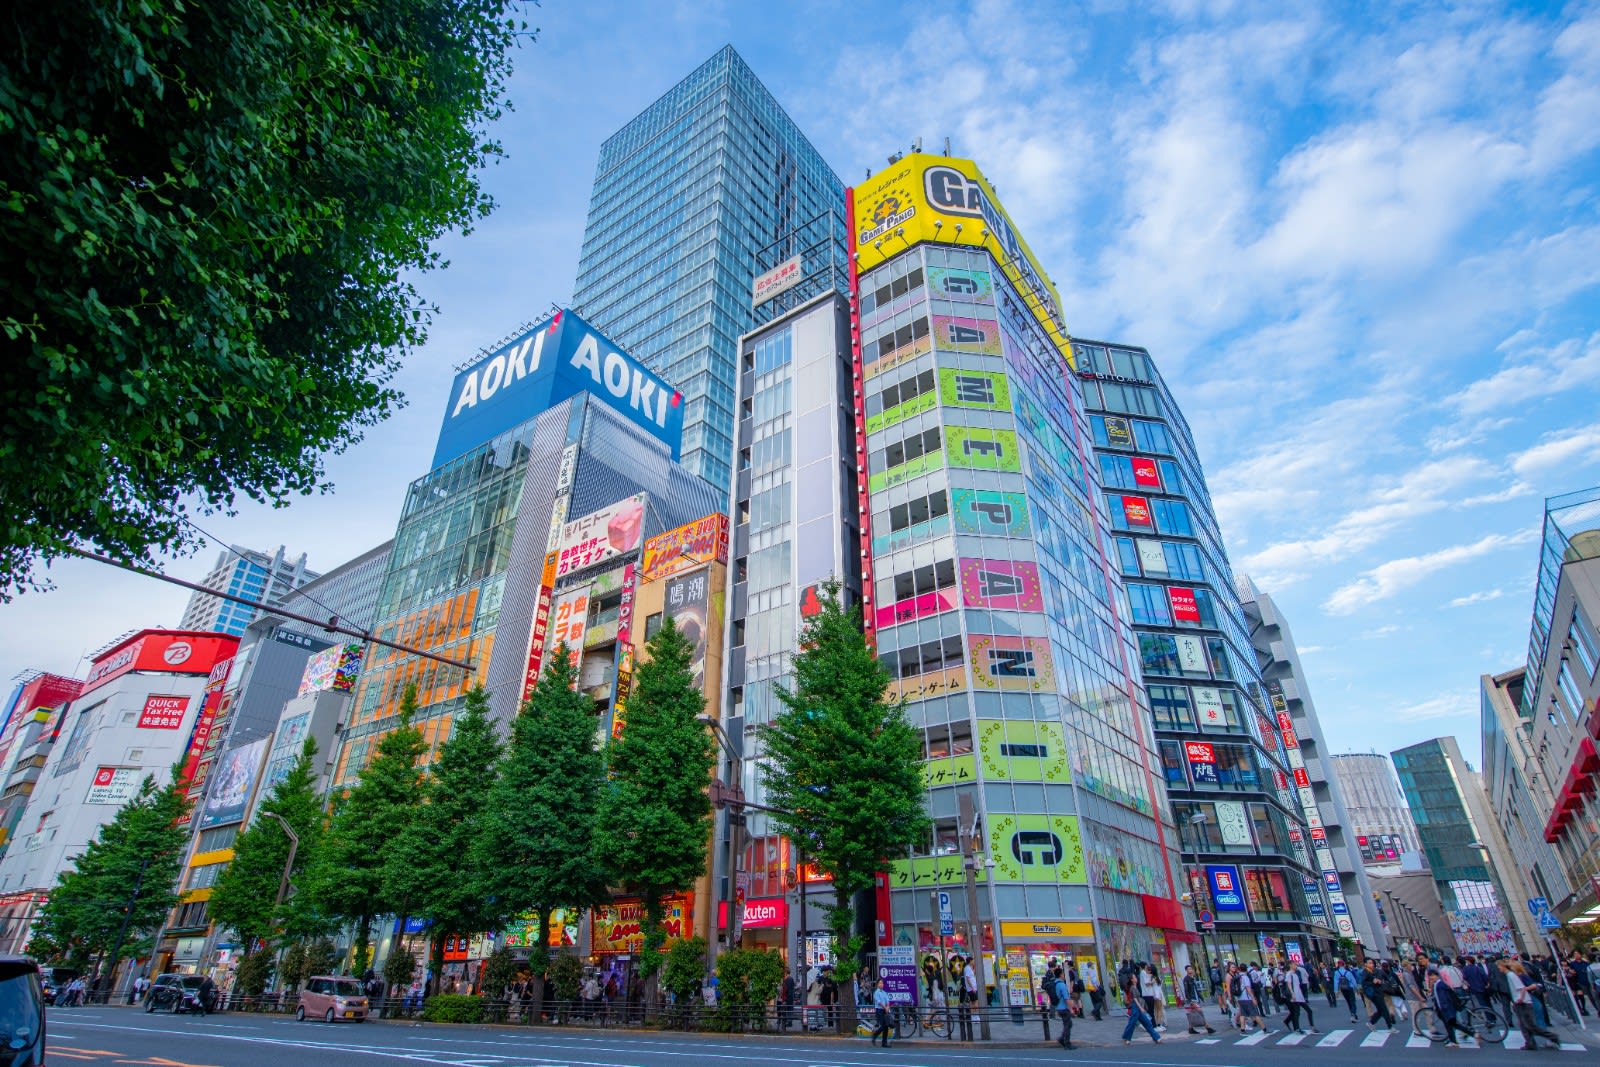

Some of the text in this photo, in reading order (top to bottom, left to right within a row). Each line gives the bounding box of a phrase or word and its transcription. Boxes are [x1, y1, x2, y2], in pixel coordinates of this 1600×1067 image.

[860, 208, 913, 243] GAME PANIC
[874, 347, 922, 374] ビデオゲーム
[452, 329, 547, 418] AOKI
[569, 332, 668, 429] AOKI
[696, 517, 716, 536] DVD
[561, 537, 607, 560] 曲数世界一
[559, 548, 605, 575] カラオケ
[670, 576, 705, 605] 鳴潮
[1171, 596, 1195, 604] カラオケ
[895, 602, 941, 621] 音楽ゲーム
[888, 678, 960, 702] クレーンゲーム
[146, 707, 183, 716] Tax Free
[148, 699, 180, 708] QUICK
[925, 767, 969, 785] ンゲーム
[743, 904, 776, 920] kuten
[940, 893, 949, 910] P
